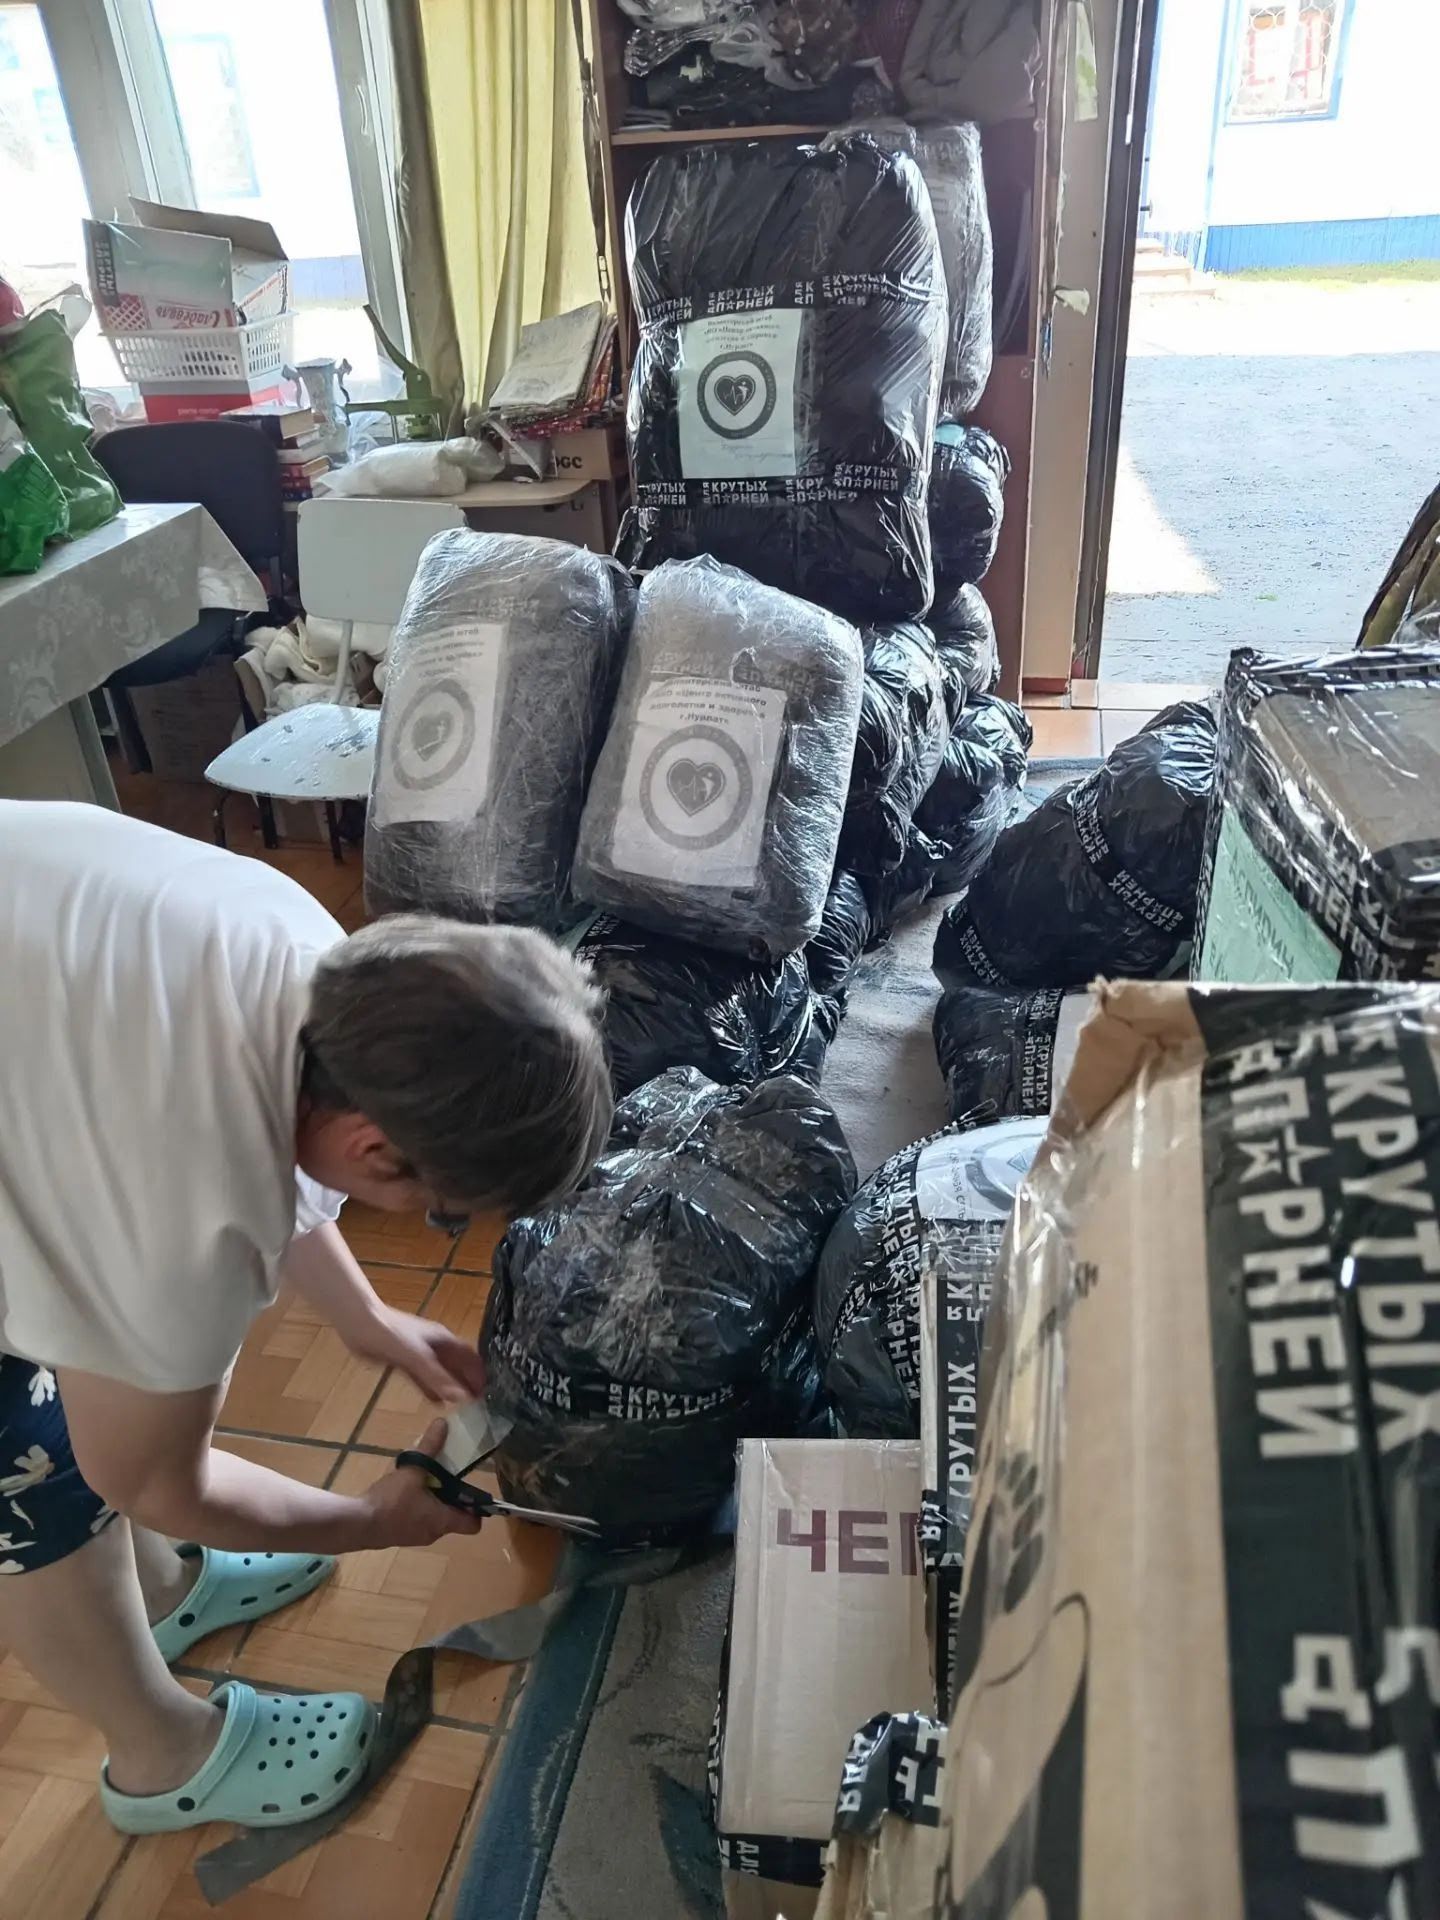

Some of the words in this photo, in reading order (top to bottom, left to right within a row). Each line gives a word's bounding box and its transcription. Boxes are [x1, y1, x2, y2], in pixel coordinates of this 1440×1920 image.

[717, 285, 775, 301] КРУТЫХ
[712, 480, 768, 493] КРУТЫХ
[845, 464, 898, 479] КРУТЫХ
[1108, 876, 1165, 926] КРУТЫХ
[1036, 1044, 1048, 1107] КРУТЫХ
[1325, 1062, 1440, 1455] КРУТЫХ
